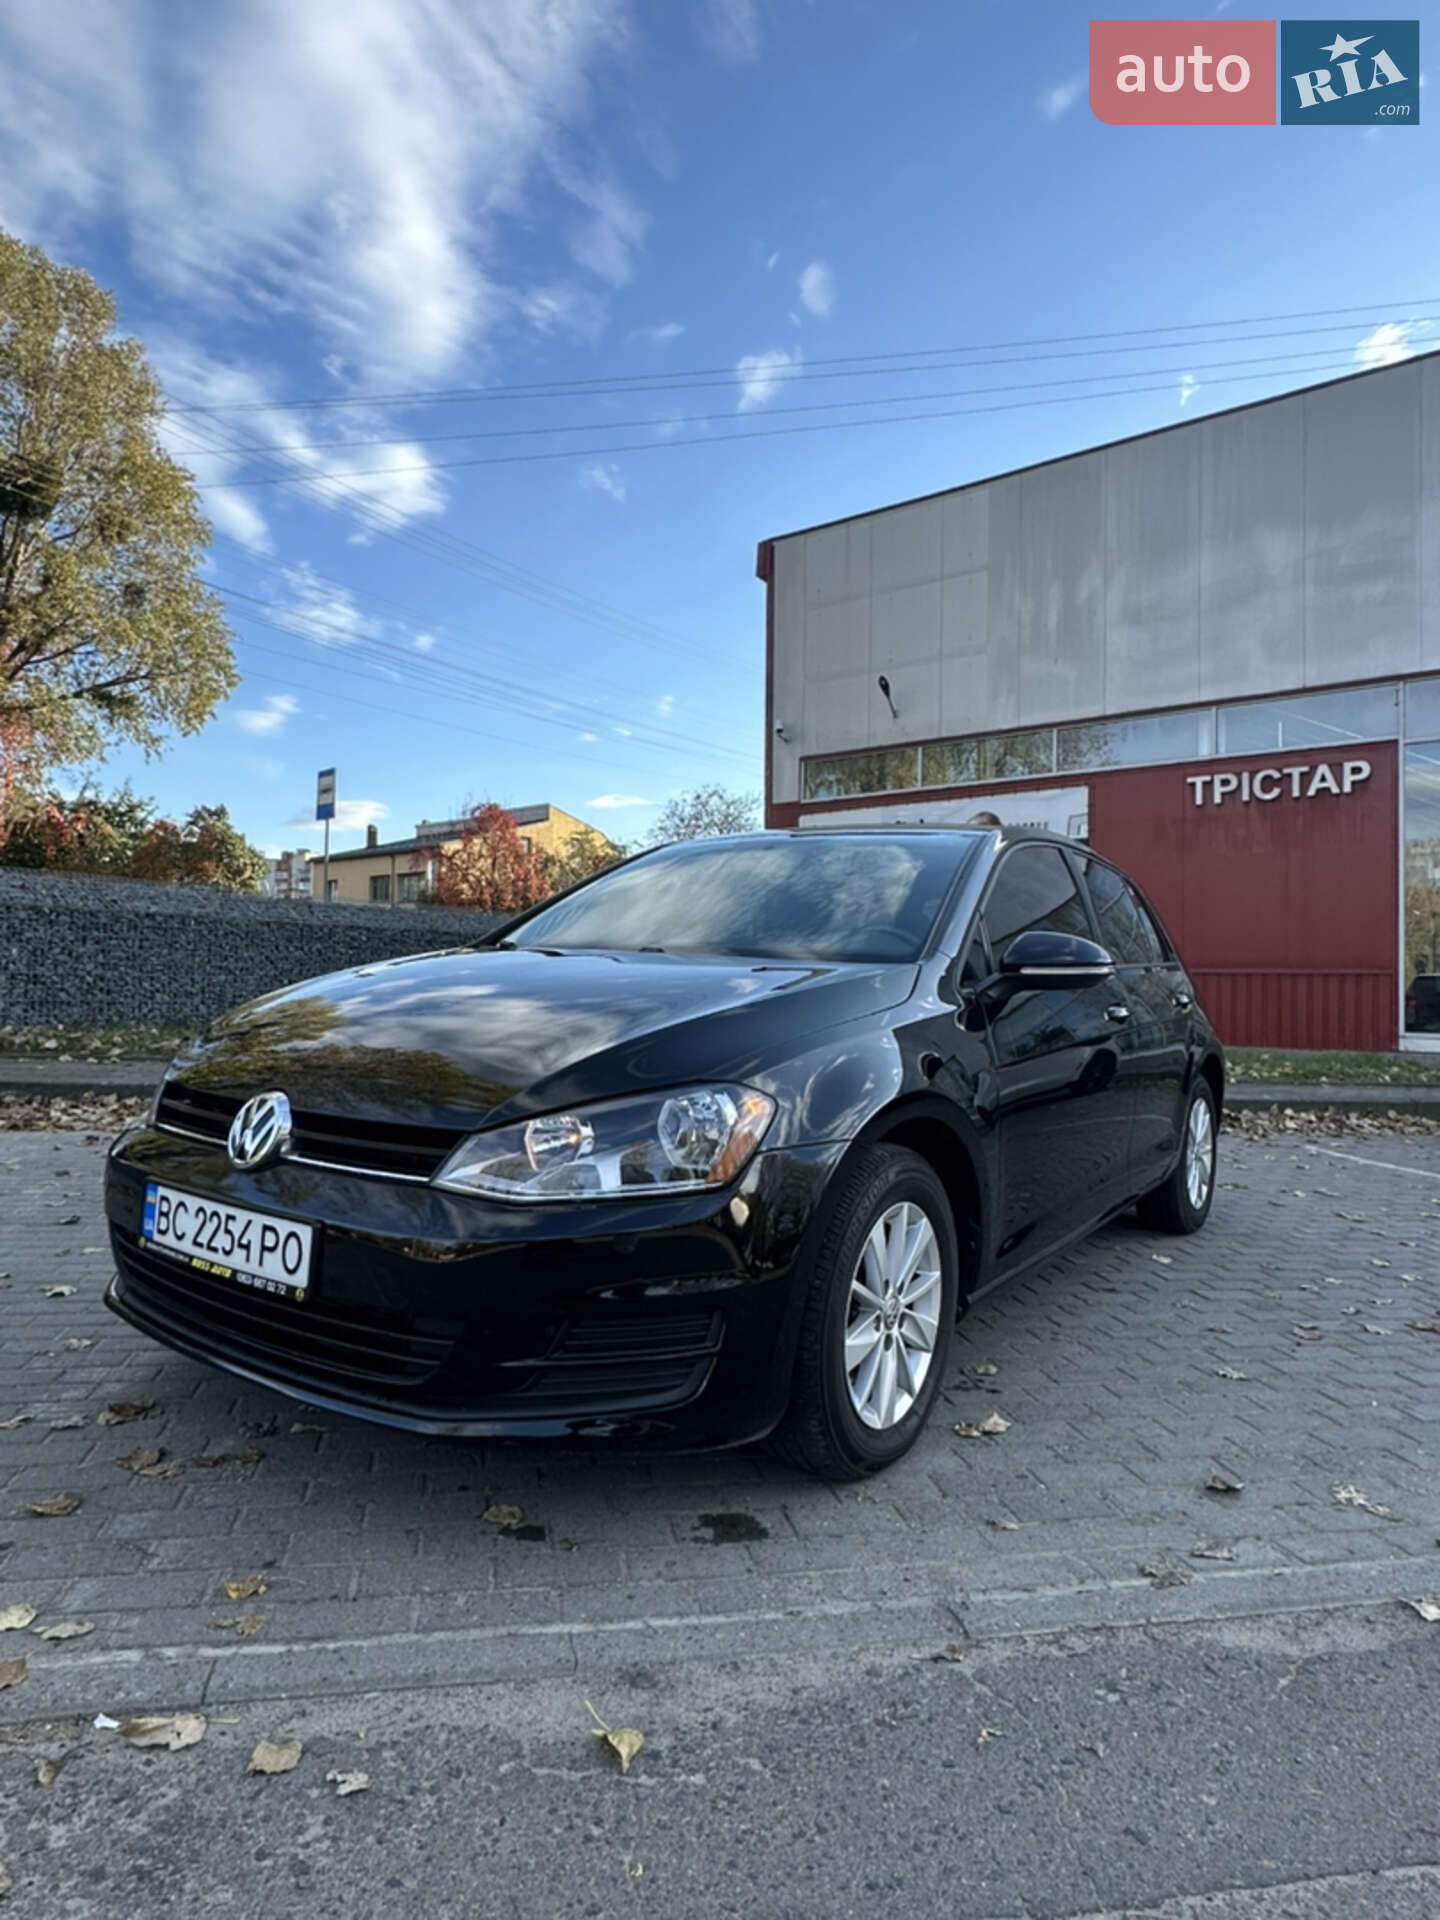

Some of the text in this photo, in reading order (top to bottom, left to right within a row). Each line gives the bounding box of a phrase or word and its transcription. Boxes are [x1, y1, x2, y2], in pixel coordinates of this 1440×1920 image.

[1186, 760, 1372, 806] ТРІСТАР
[156, 1194, 304, 1276] BC 2254 PO
